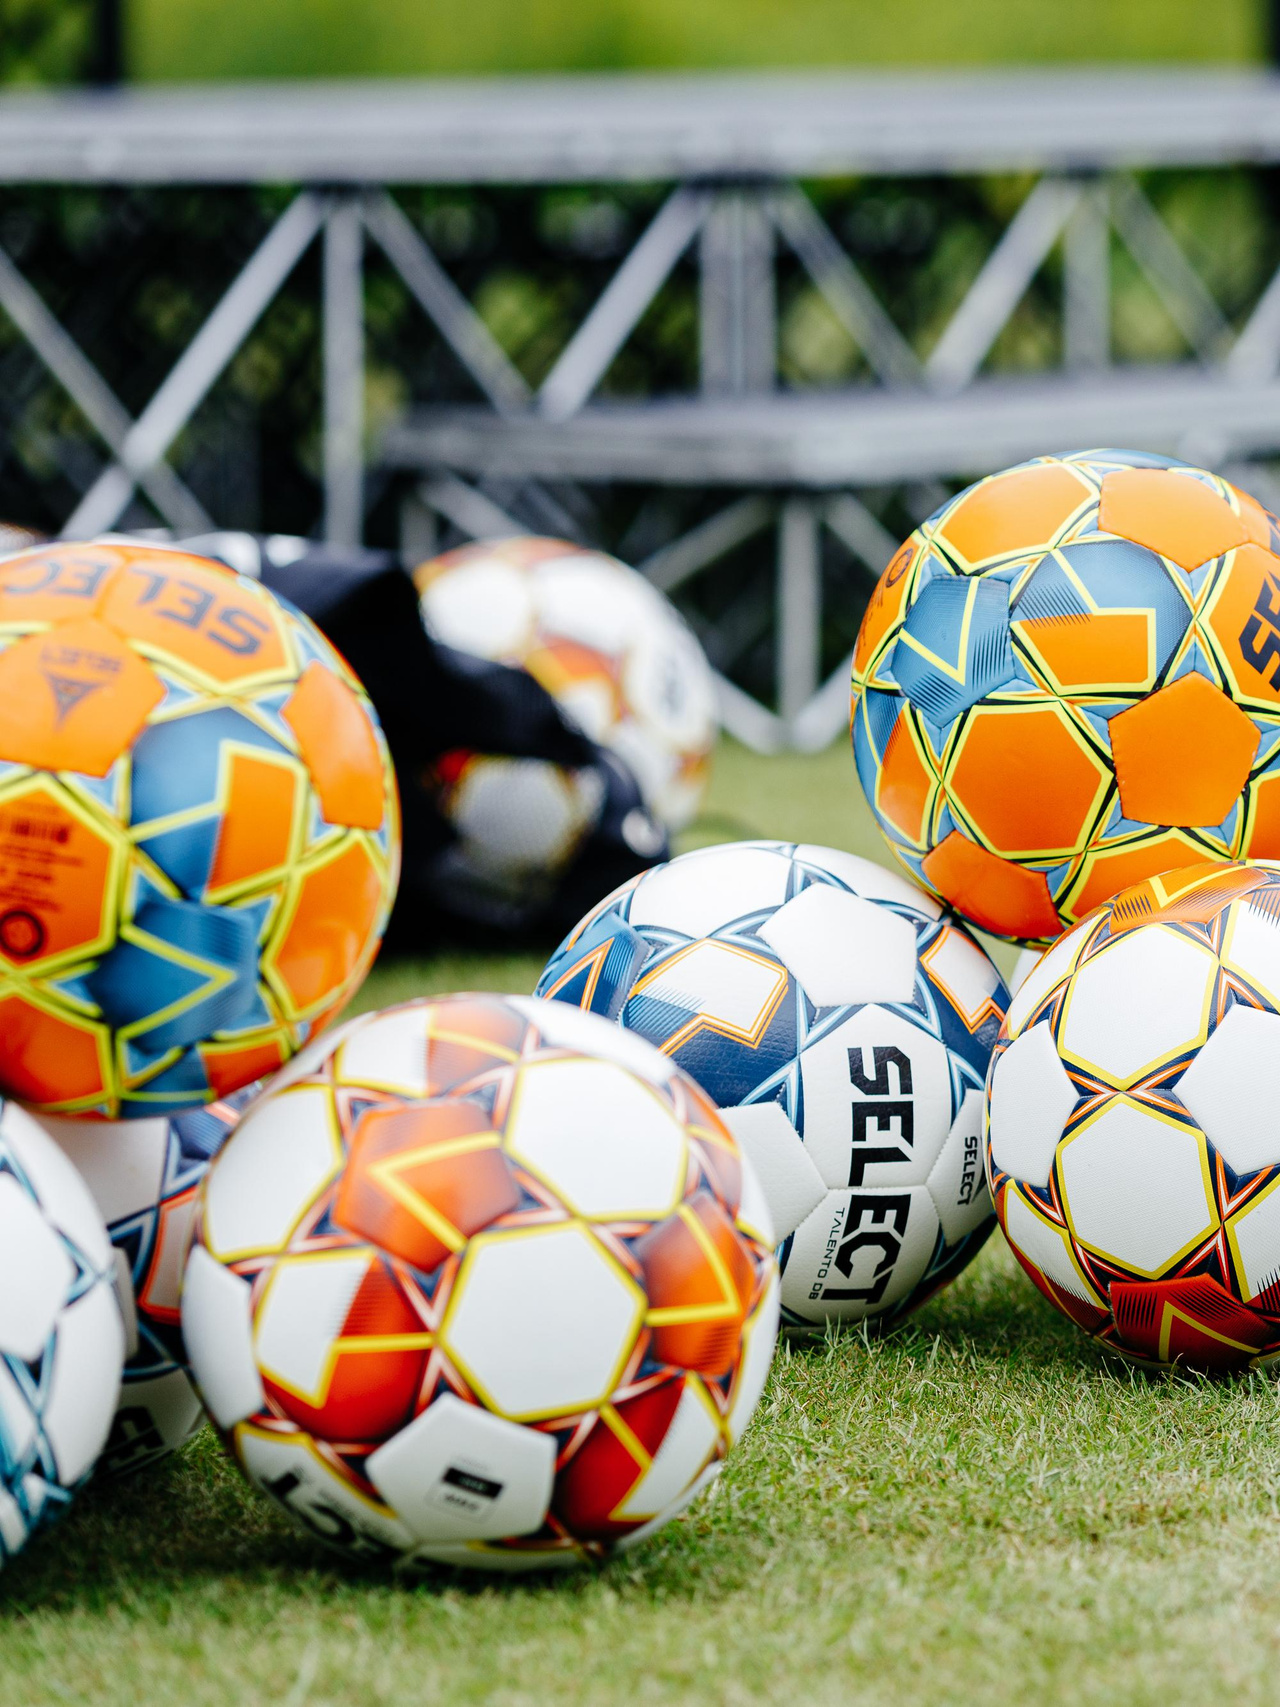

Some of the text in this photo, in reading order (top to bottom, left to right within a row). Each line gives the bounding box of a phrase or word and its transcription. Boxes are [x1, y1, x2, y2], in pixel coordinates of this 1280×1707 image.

[2, 558, 270, 657] SELEC
[820, 1045, 915, 1306] SELECT
[956, 1135, 978, 1206] SELECT
[808, 1207, 846, 1300] TALENTO DB
